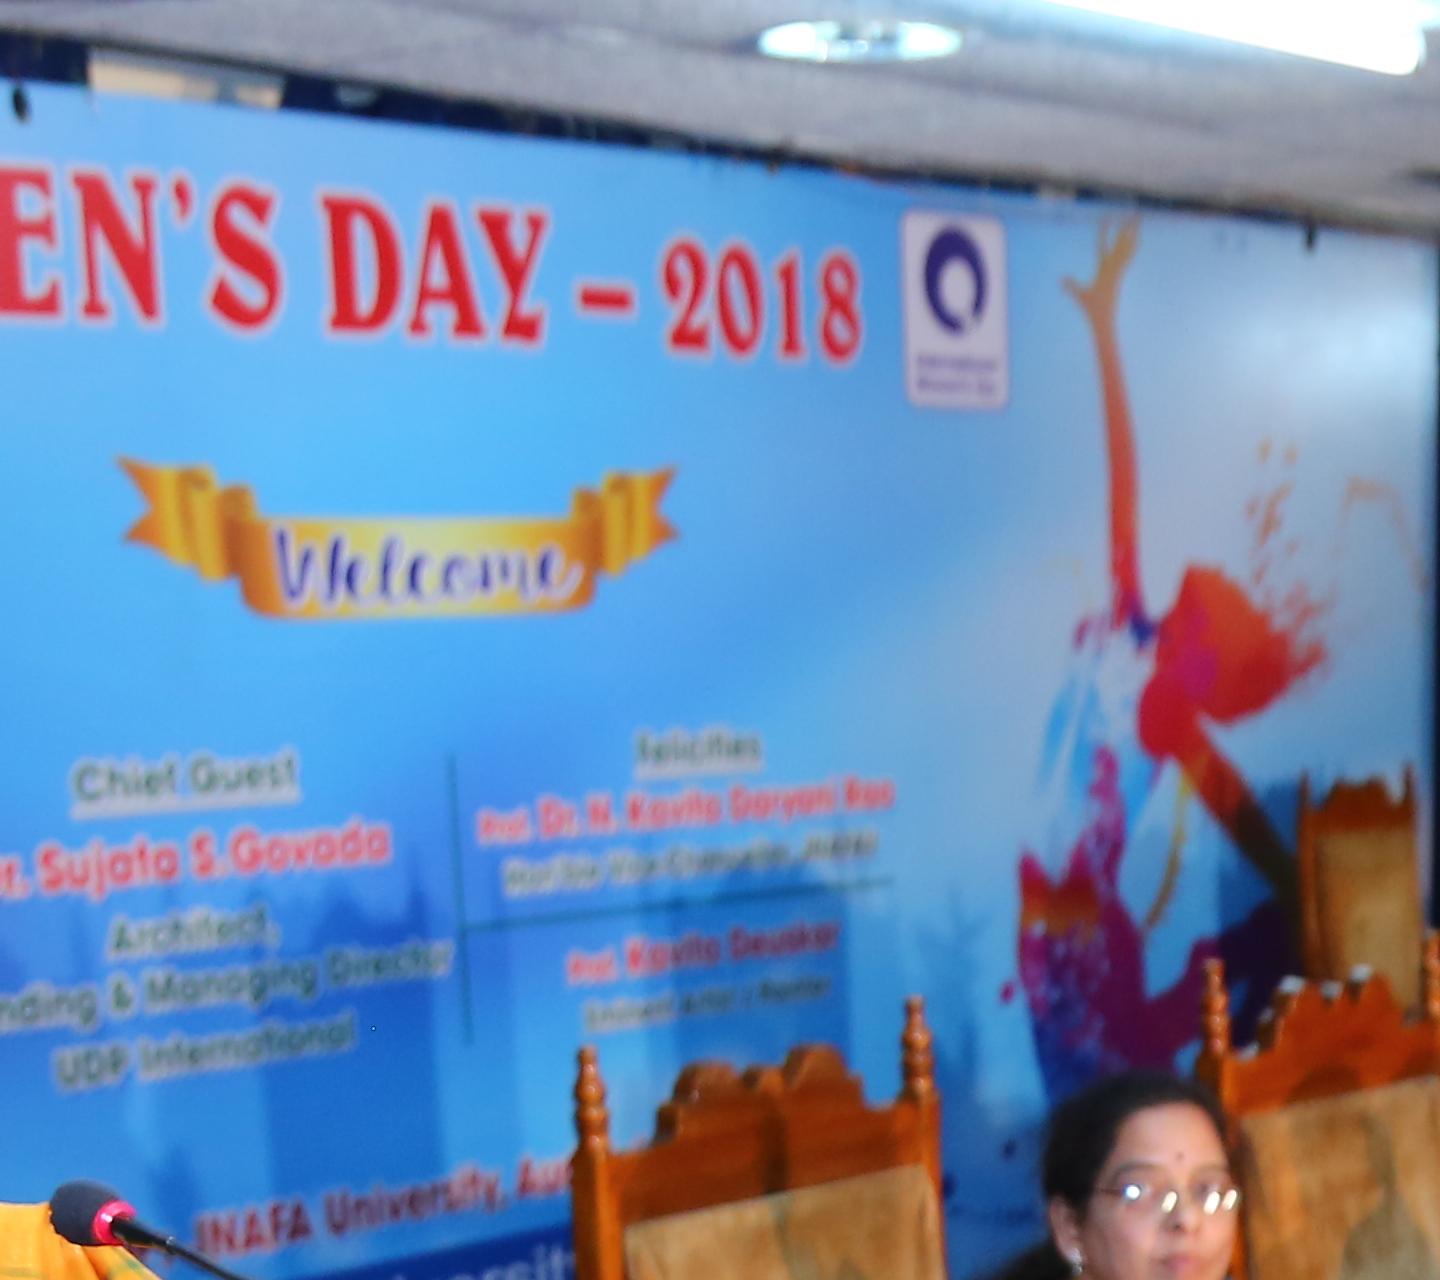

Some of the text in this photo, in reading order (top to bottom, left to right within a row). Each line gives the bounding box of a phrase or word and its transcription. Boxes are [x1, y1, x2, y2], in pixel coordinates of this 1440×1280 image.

[317, 190, 548, 344] DAY
[662, 238, 862, 362] 2018
[273, 526, 584, 605] Welcome
[71, 748, 299, 802] Chief Guest
[38, 836, 181, 902] Sujata
